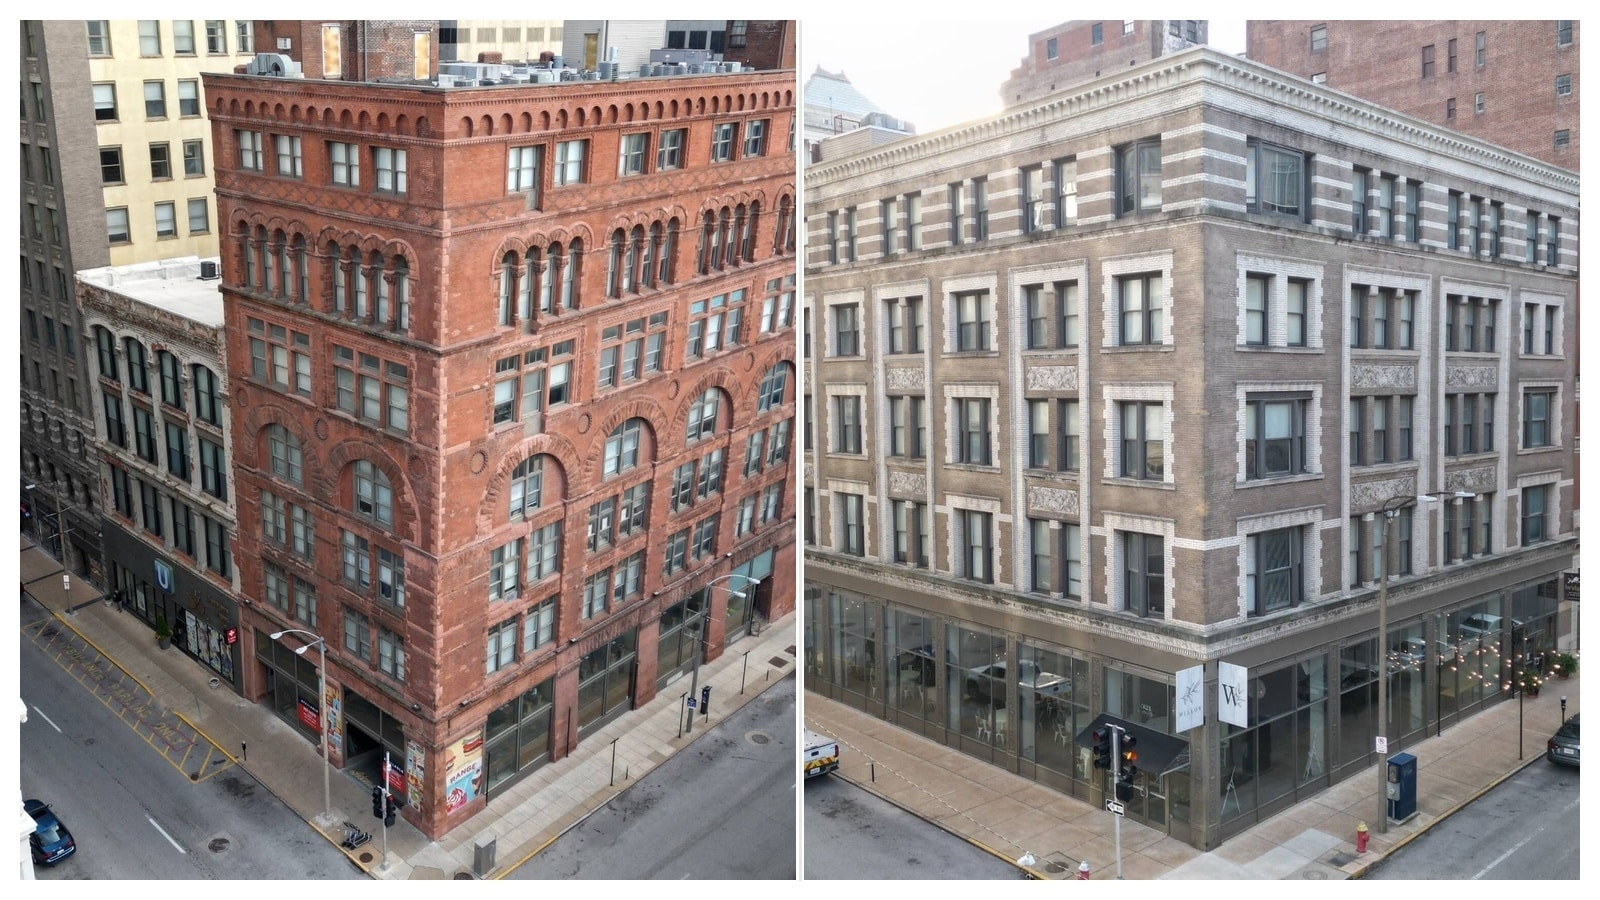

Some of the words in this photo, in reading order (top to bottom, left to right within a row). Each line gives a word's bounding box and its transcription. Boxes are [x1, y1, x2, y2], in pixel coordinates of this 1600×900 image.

[1221, 683, 1237, 707] W
[1179, 705, 1202, 717] WILLOW
[154, 722, 185, 745] ONLY
[450, 763, 477, 783] RANGE
